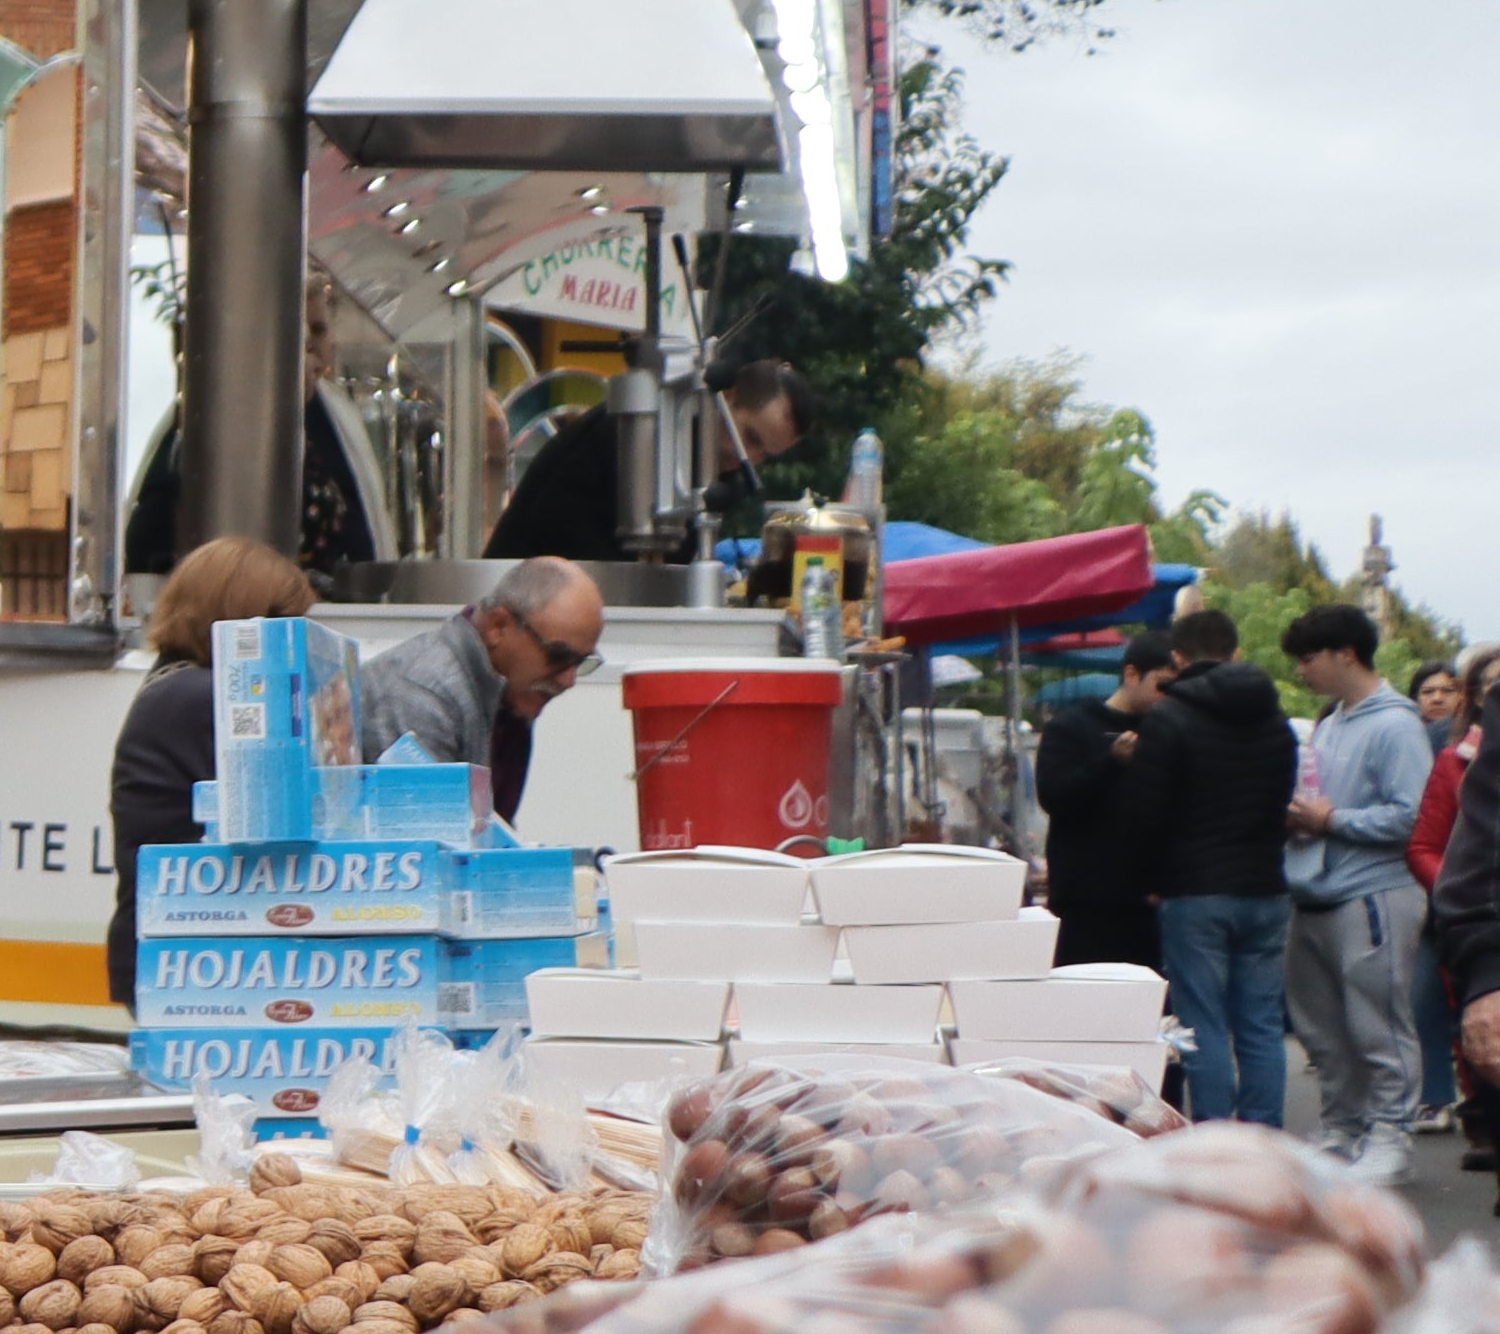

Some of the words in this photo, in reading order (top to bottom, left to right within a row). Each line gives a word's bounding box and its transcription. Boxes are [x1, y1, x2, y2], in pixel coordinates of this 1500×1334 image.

[559, 273, 637, 311] MARIA
[157, 851, 424, 896] HOJALDRES
[164, 910, 248, 922] ASTORGA
[155, 947, 423, 991] HOJALDRES
[163, 1005, 247, 1016] ASTORGA
